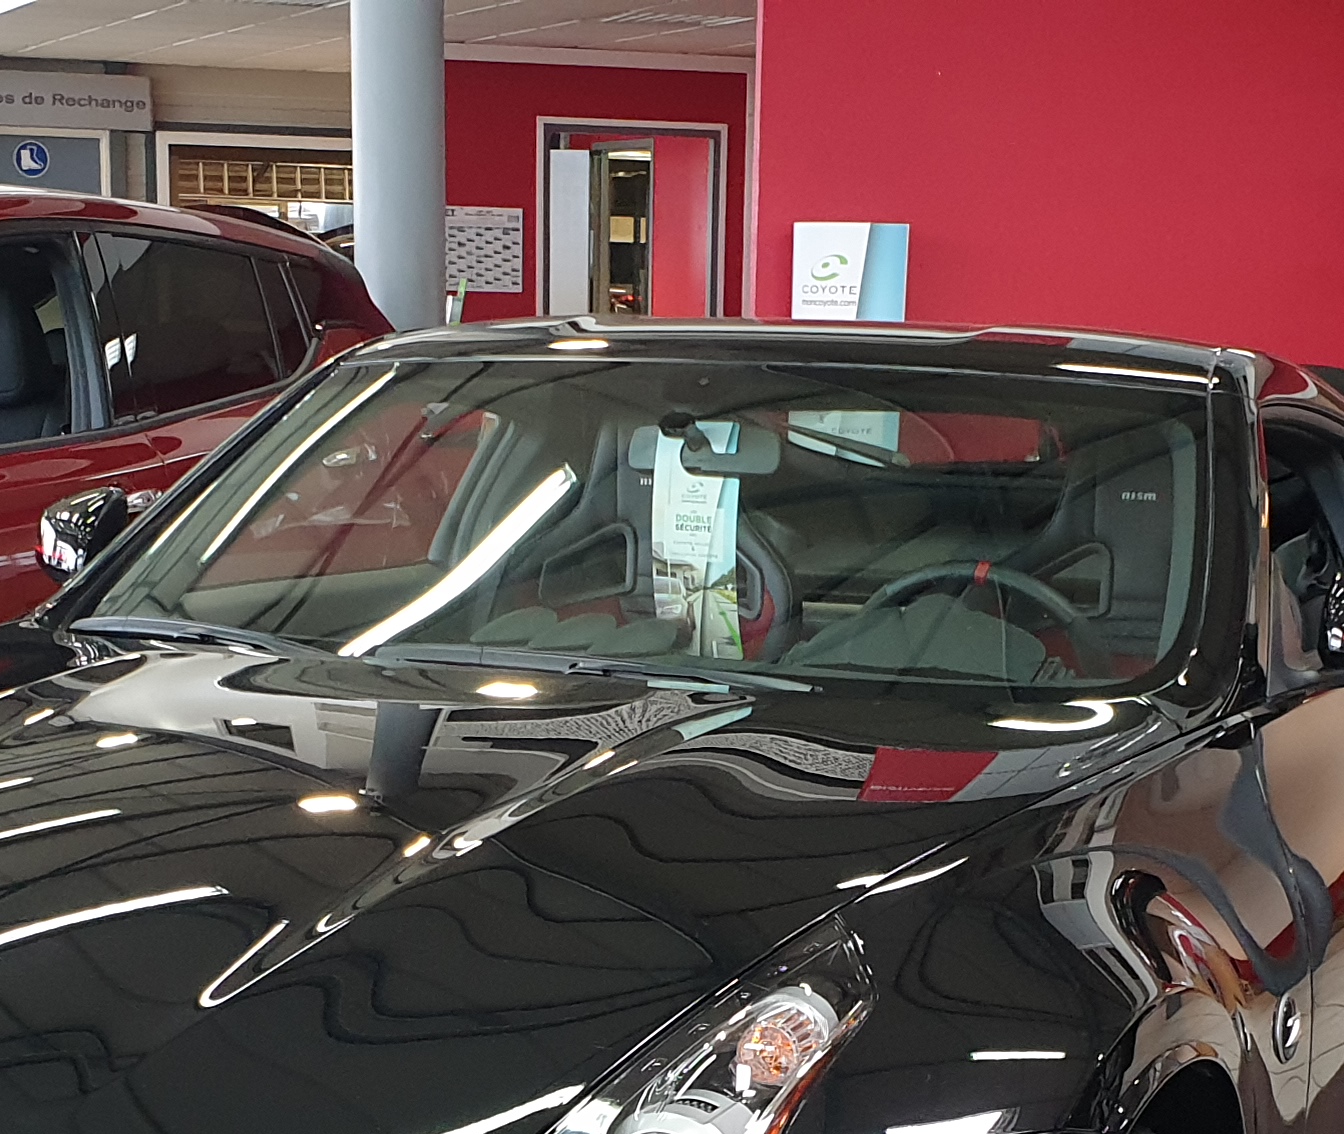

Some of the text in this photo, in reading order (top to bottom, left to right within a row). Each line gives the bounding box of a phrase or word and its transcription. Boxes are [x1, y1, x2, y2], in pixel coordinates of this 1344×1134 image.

[21, 91, 44, 106] de
[51, 92, 147, 113] Rechange
[801, 284, 858, 295] COYOTE
[675, 513, 712, 524] DOUBLE
